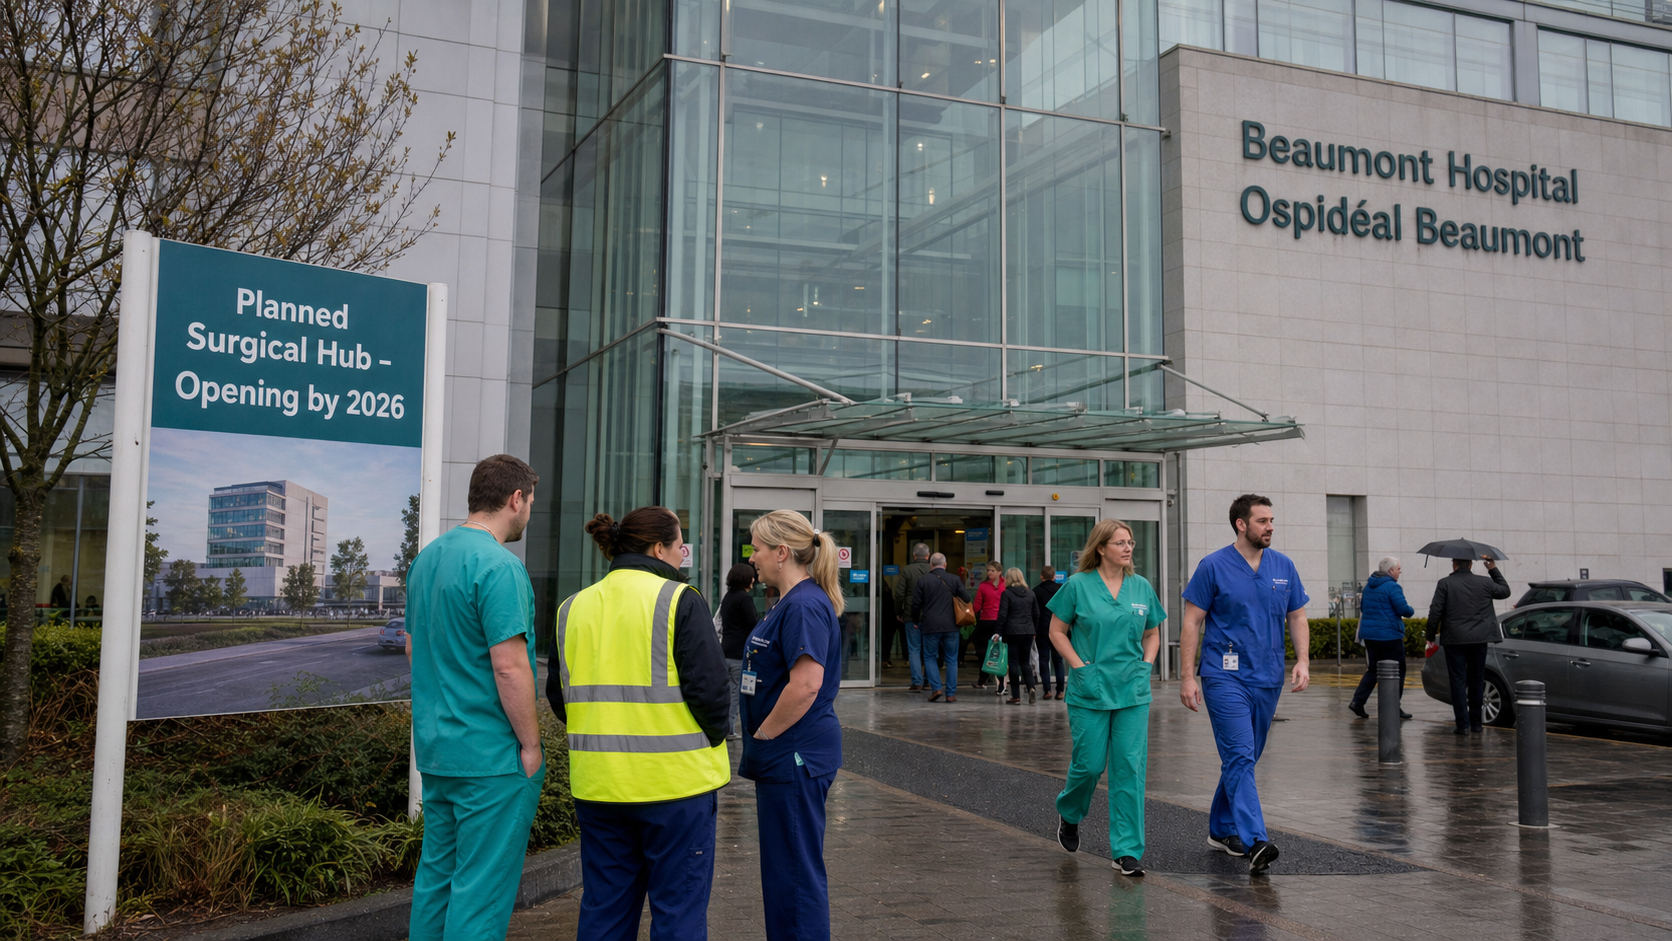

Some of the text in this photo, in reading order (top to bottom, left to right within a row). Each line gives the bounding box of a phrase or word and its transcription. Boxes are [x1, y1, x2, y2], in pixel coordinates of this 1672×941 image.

[1241, 119, 1579, 205] Beaumont Hospital
[1240, 184, 1586, 262] Ospidéal Beaumont
[236, 287, 349, 330] Planned
[186, 321, 307, 364] Surgical
[318, 339, 372, 370] Hub
[175, 370, 405, 420] Opening by 2026
